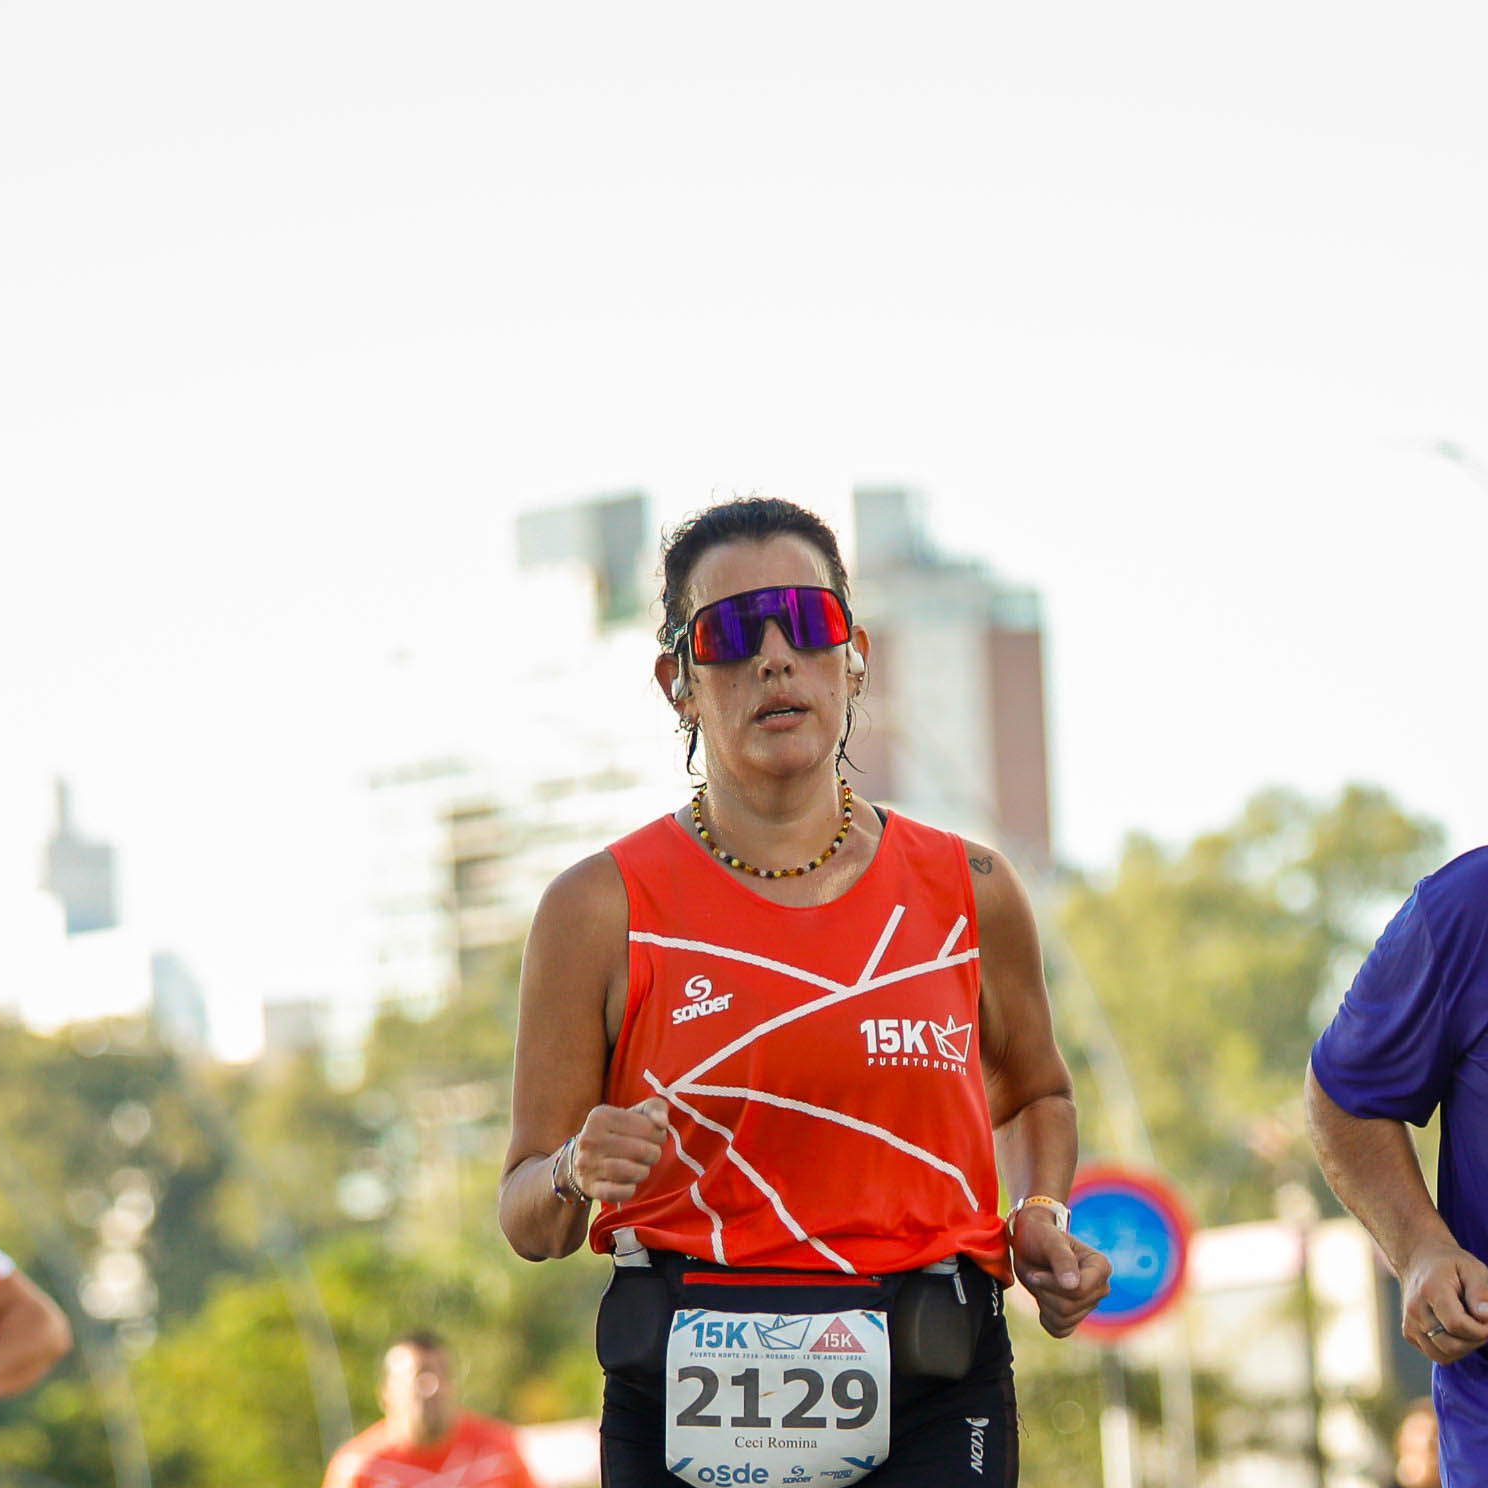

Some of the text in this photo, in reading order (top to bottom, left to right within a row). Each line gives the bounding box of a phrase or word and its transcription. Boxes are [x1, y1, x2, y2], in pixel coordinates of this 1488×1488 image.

[859, 1018, 929, 1055] 15K
[867, 1057, 967, 1076] PUERTO NORTE
[692, 1321, 749, 1349] 15K
[823, 1333, 853, 1348] 15K
[675, 1365, 879, 1430] 2129
[734, 1436, 818, 1449] Ceci Romina
[697, 1462, 769, 1485] osde
